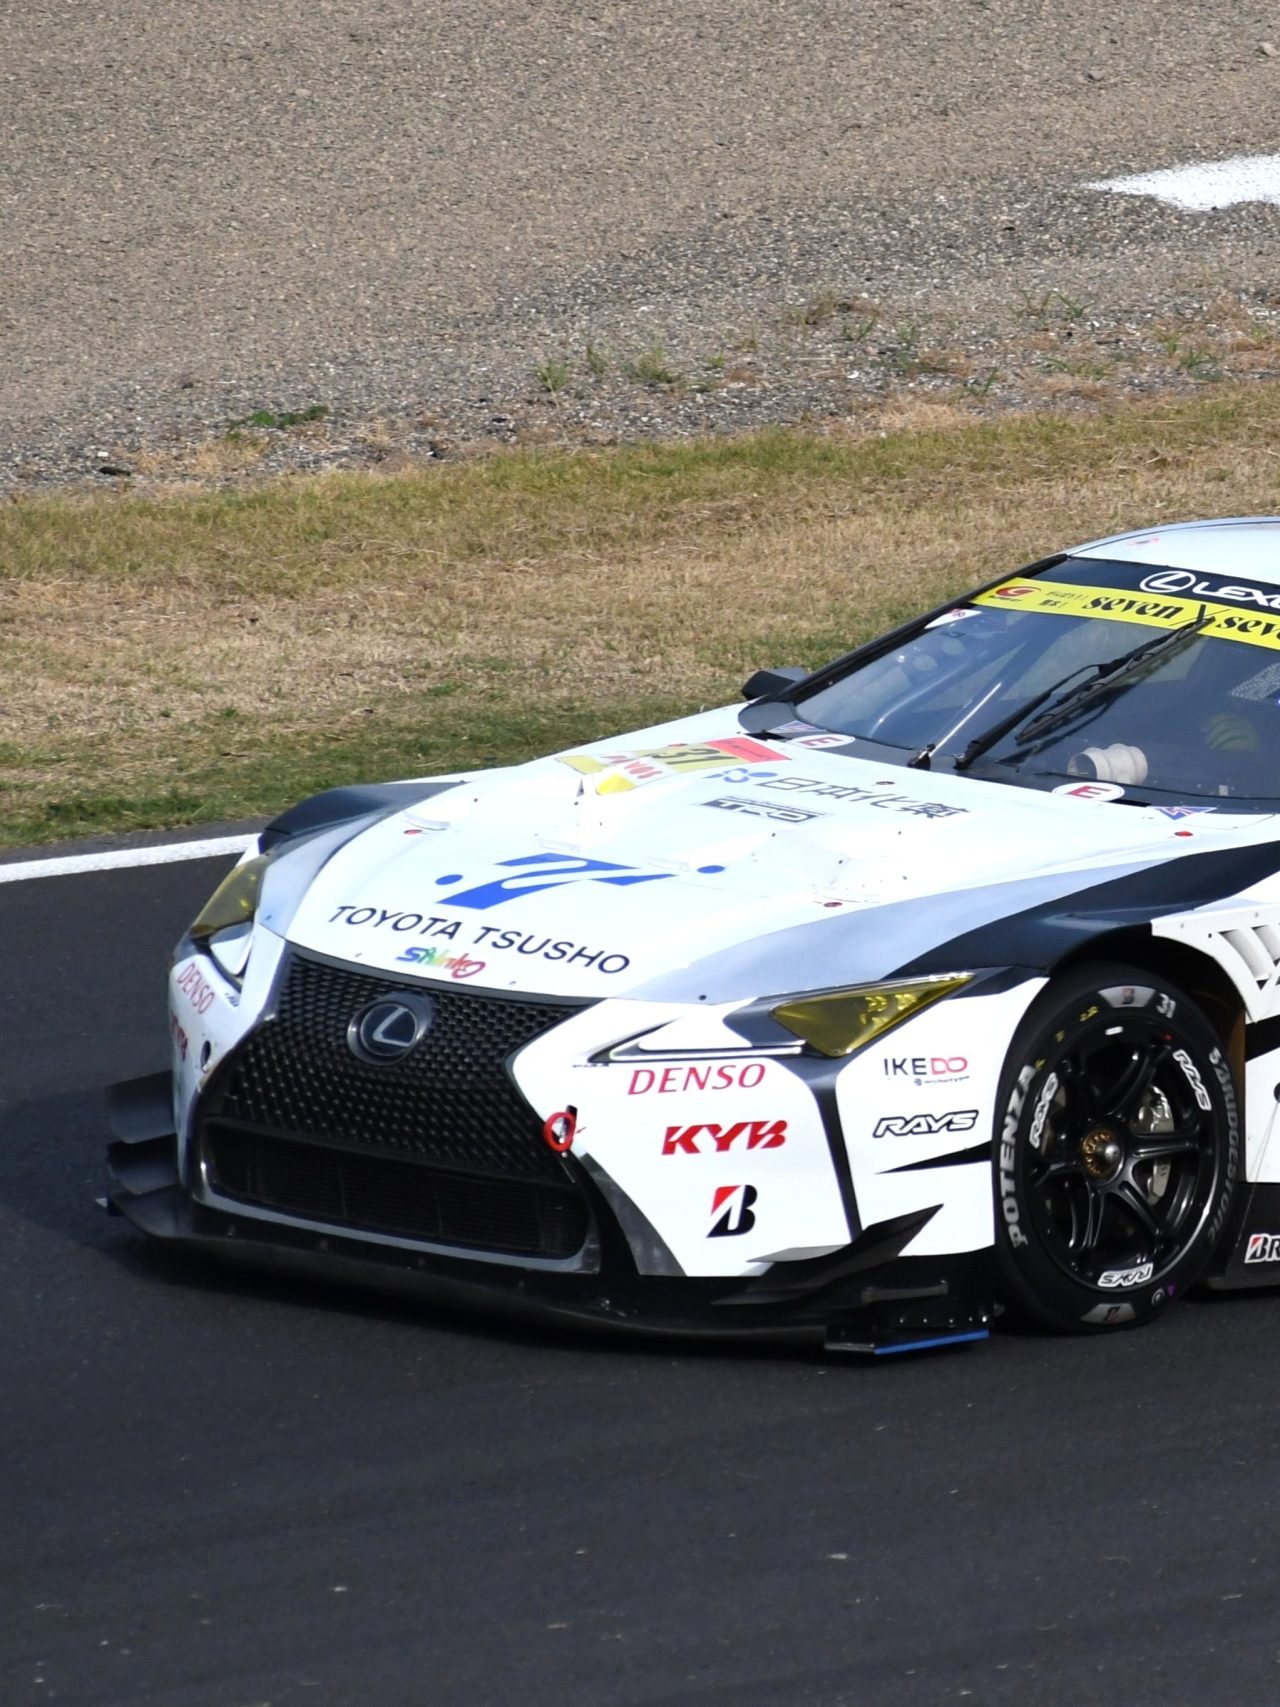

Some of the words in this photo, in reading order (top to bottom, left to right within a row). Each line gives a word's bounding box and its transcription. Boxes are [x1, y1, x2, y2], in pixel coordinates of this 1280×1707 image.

[1082, 596, 1184, 619] seven
[327, 905, 463, 940] TOYOTA
[472, 926, 631, 975] TSUSHO
[176, 962, 215, 1015] DENSO
[627, 1063, 766, 1095] DENSO
[884, 1056, 968, 1076] IKEDO
[661, 1119, 788, 1156] KYB
[872, 1109, 980, 1139] RAYS
[1000, 1064, 1037, 1249] POTENZA
[1206, 1062, 1239, 1243] BRIDGESTONE
